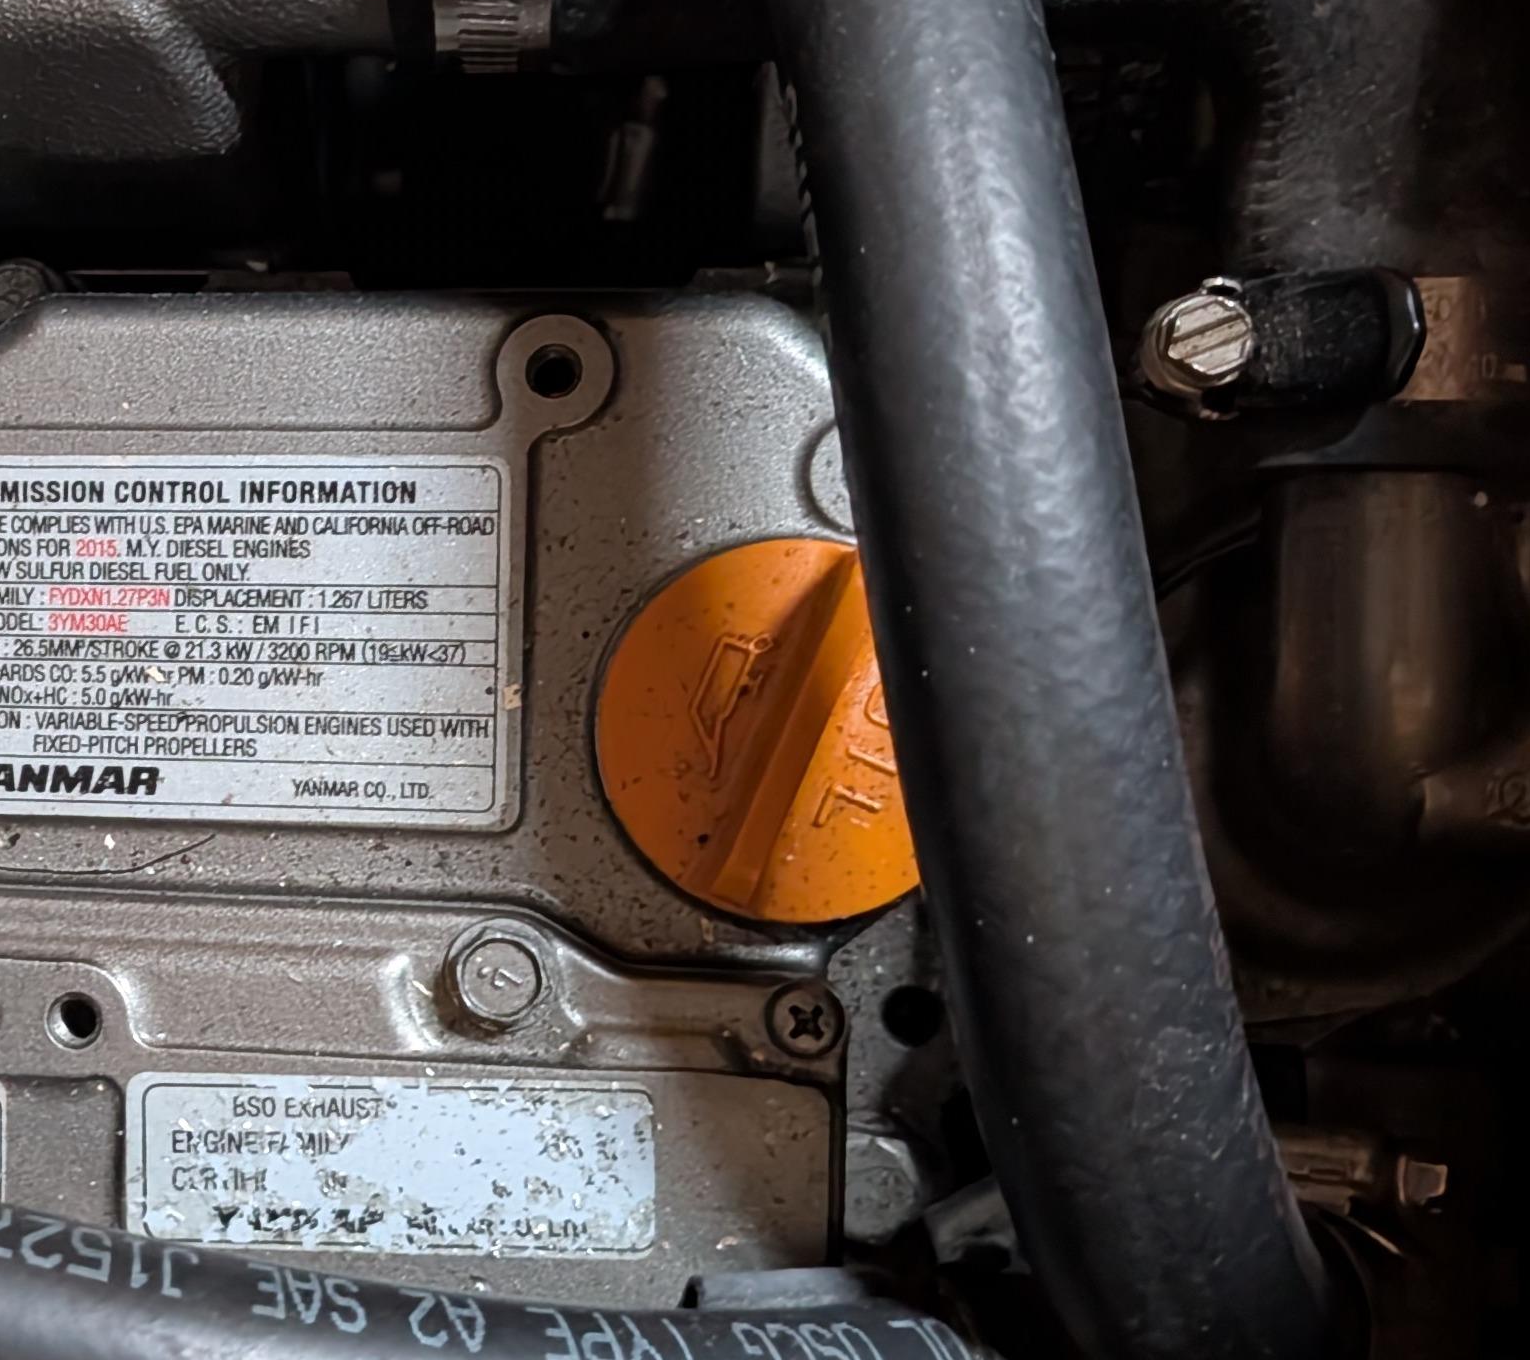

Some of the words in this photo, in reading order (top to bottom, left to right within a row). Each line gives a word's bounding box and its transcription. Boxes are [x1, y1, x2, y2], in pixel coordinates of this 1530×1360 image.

[115, 481, 229, 503] CONTROL
[240, 481, 416, 504] INFORMATION
[11, 515, 90, 534] COMPLIES
[95, 516, 135, 534] WITH
[140, 517, 169, 534] U.S.
[173, 516, 204, 535] EPA
[207, 516, 271, 535] MARINE
[273, 516, 308, 535] AND
[312, 517, 409, 535] CALIFORNIA
[413, 517, 495, 535] OFF-ROAD
[37, 539, 70, 557] FOR
[126, 540, 161, 557] M.Y.
[166, 540, 228, 558] DIESEL
[234, 540, 311, 558] ENGINES
[16, 561, 84, 580] SULFUR
[91, 562, 149, 580] DIESEL
[154, 562, 199, 581] FUEL
[202, 562, 251, 581] ONLY.
[174, 588, 302, 607] DISPLACEMENT
[367, 590, 429, 609] LITERS
[48, 614, 128, 633] 3YM30AE
[164, 642, 180, 658] @
[185, 643, 222, 660] 21.3
[225, 643, 252, 660] kW
[268, 643, 310, 660] 3200
[315, 643, 356, 661] RPM
[81, 665, 106, 683] 5.5
[178, 667, 204, 685] PM
[218, 668, 253, 685] 0.20
[258, 668, 323, 689] g/kW-hr
[81, 687, 106, 705] 5.0
[110, 687, 173, 708] g/kW-hr
[35, 712, 179, 732] VARIABLE-SPEED
[185, 714, 299, 734] PROPULSION
[304, 716, 382, 736] ENGINES
[388, 718, 435, 737] USED
[440, 718, 489, 738] WITH
[33, 734, 139, 754] FIXED-PITCH
[143, 736, 257, 757] PROPELLERS
[292, 778, 359, 797] YANMAR
[364, 781, 396, 800] CO.,
[400, 782, 433, 801] LTD.
[248, 1263, 367, 1333] SAE
[400, 1287, 486, 1353] A2
